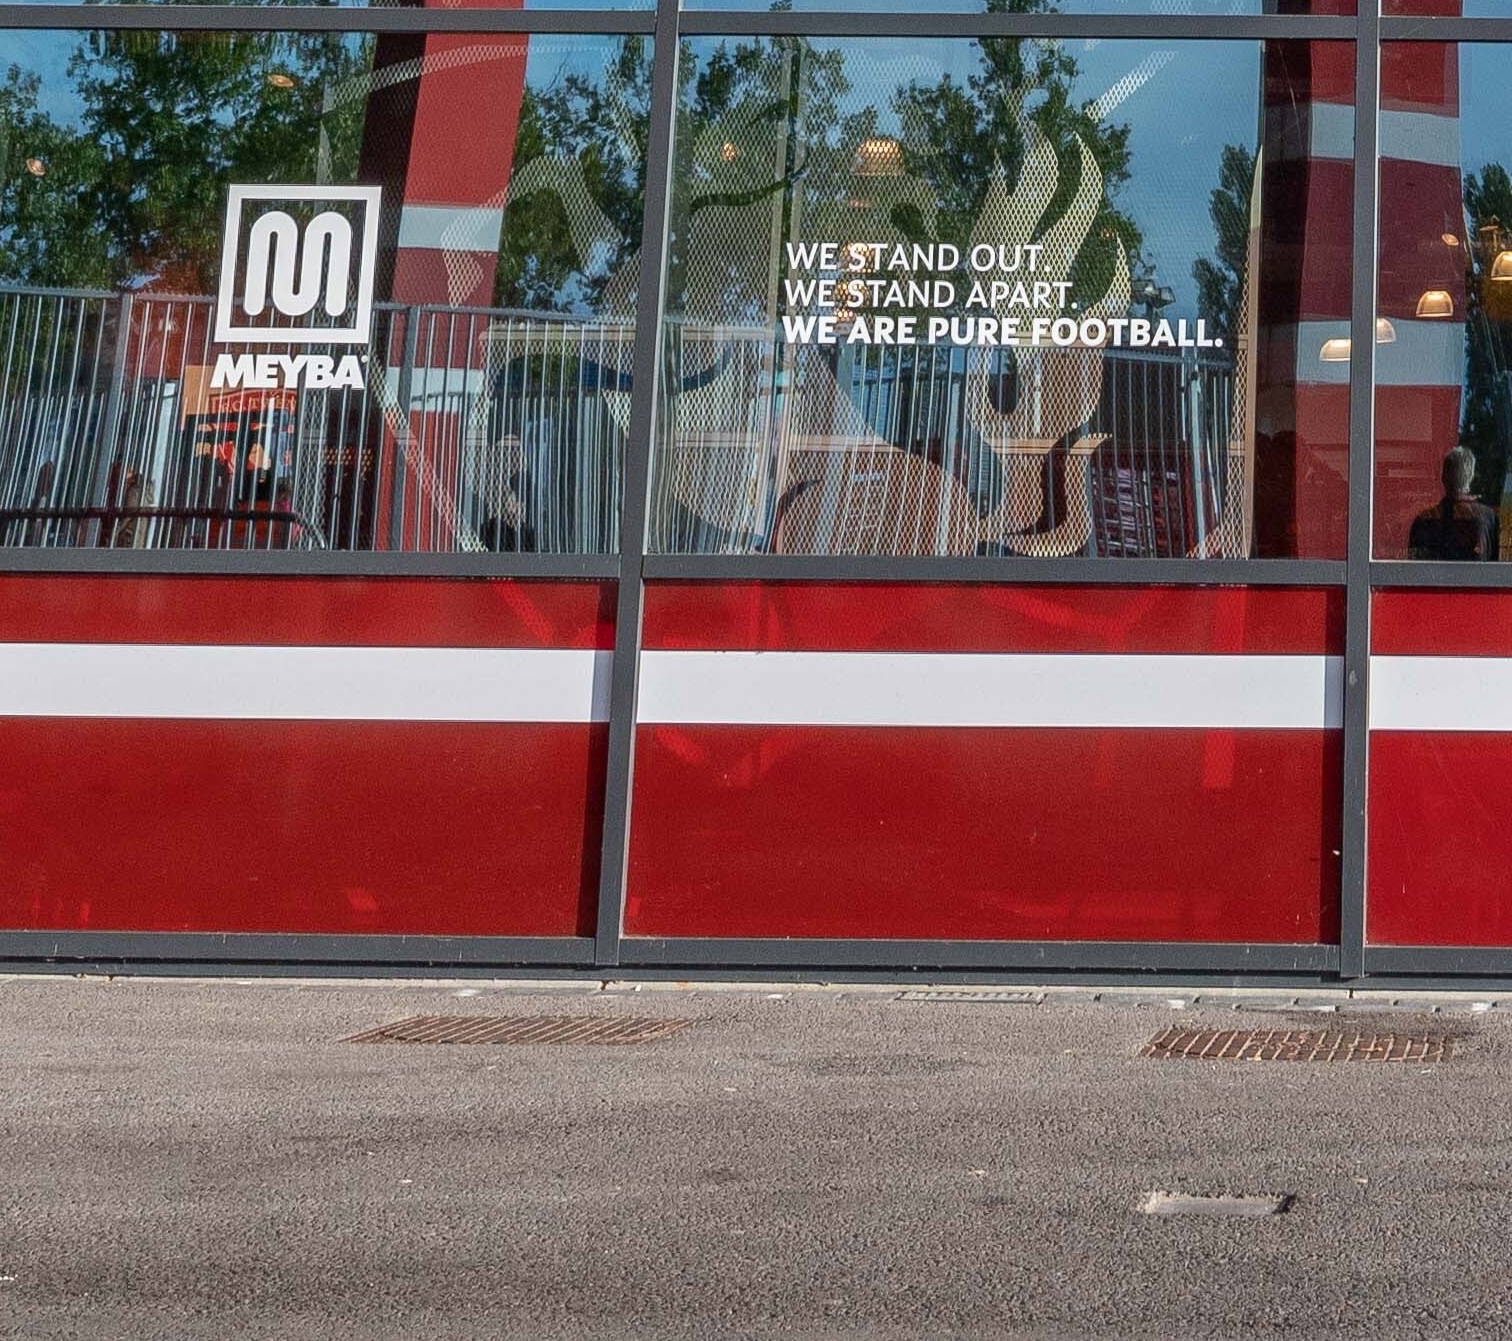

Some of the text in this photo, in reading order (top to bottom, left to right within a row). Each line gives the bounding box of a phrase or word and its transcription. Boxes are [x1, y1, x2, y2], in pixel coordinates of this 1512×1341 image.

[786, 242, 1051, 273] WE STAND OUT.
[784, 279, 1078, 310] WE STAND APART.
[781, 316, 1224, 348] WE ARE PURE FOOTBALL.
[210, 353, 366, 390] MEYBA
